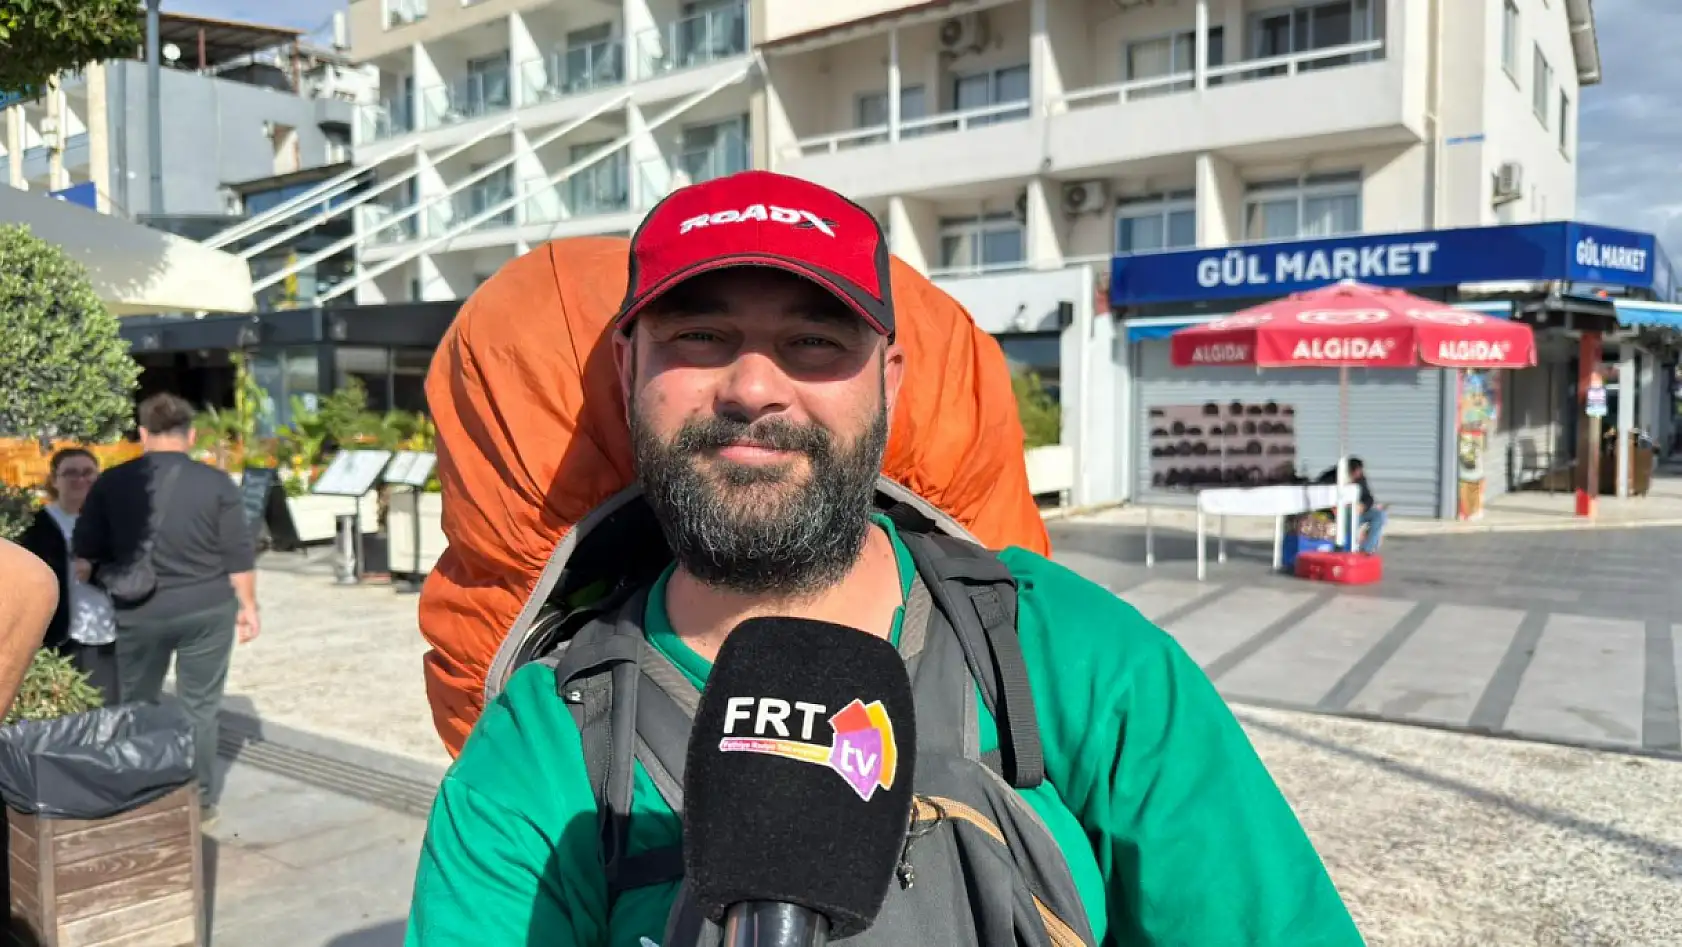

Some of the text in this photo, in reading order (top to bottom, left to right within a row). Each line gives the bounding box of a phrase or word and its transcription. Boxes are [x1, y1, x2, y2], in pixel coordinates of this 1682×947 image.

[680, 203, 836, 238] ROADX
[1196, 243, 1438, 287] GÜL MARKET
[1576, 236, 1646, 272] GÜL MARKET
[723, 697, 826, 740] FRT
[841, 740, 877, 776] tv
